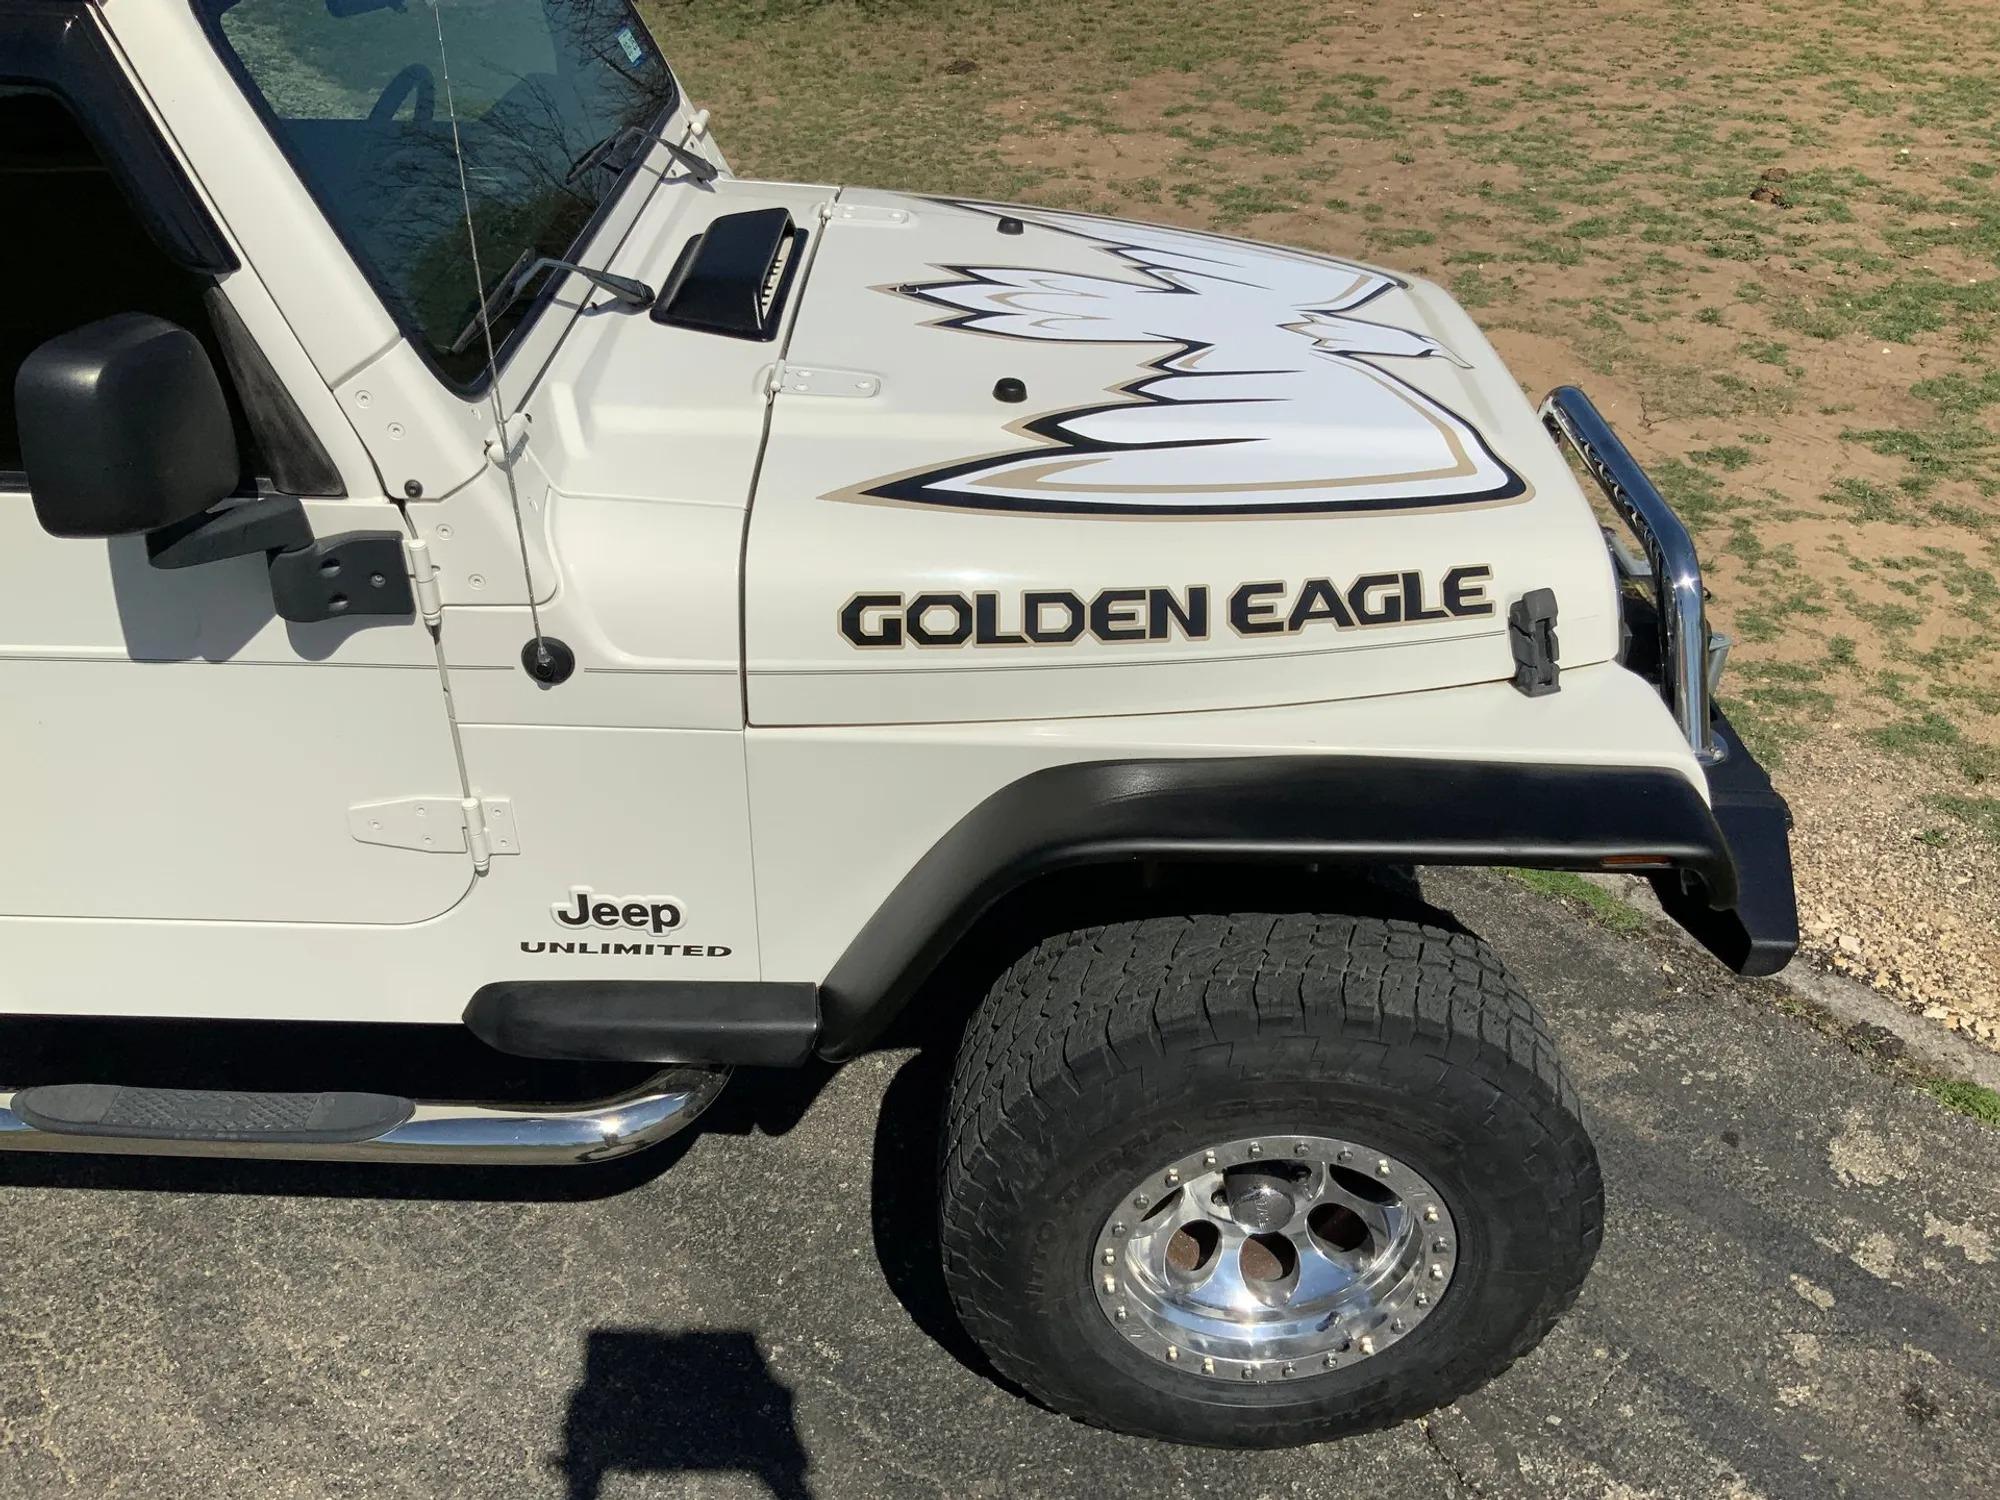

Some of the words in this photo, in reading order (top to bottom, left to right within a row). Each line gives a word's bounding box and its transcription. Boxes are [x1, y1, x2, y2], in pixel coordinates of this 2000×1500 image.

[839, 586, 1209, 647] GOLDEN
[1229, 565, 1494, 636] EAGLE
[556, 892, 682, 935] Jeep
[520, 941, 733, 957] UNLIMITED
